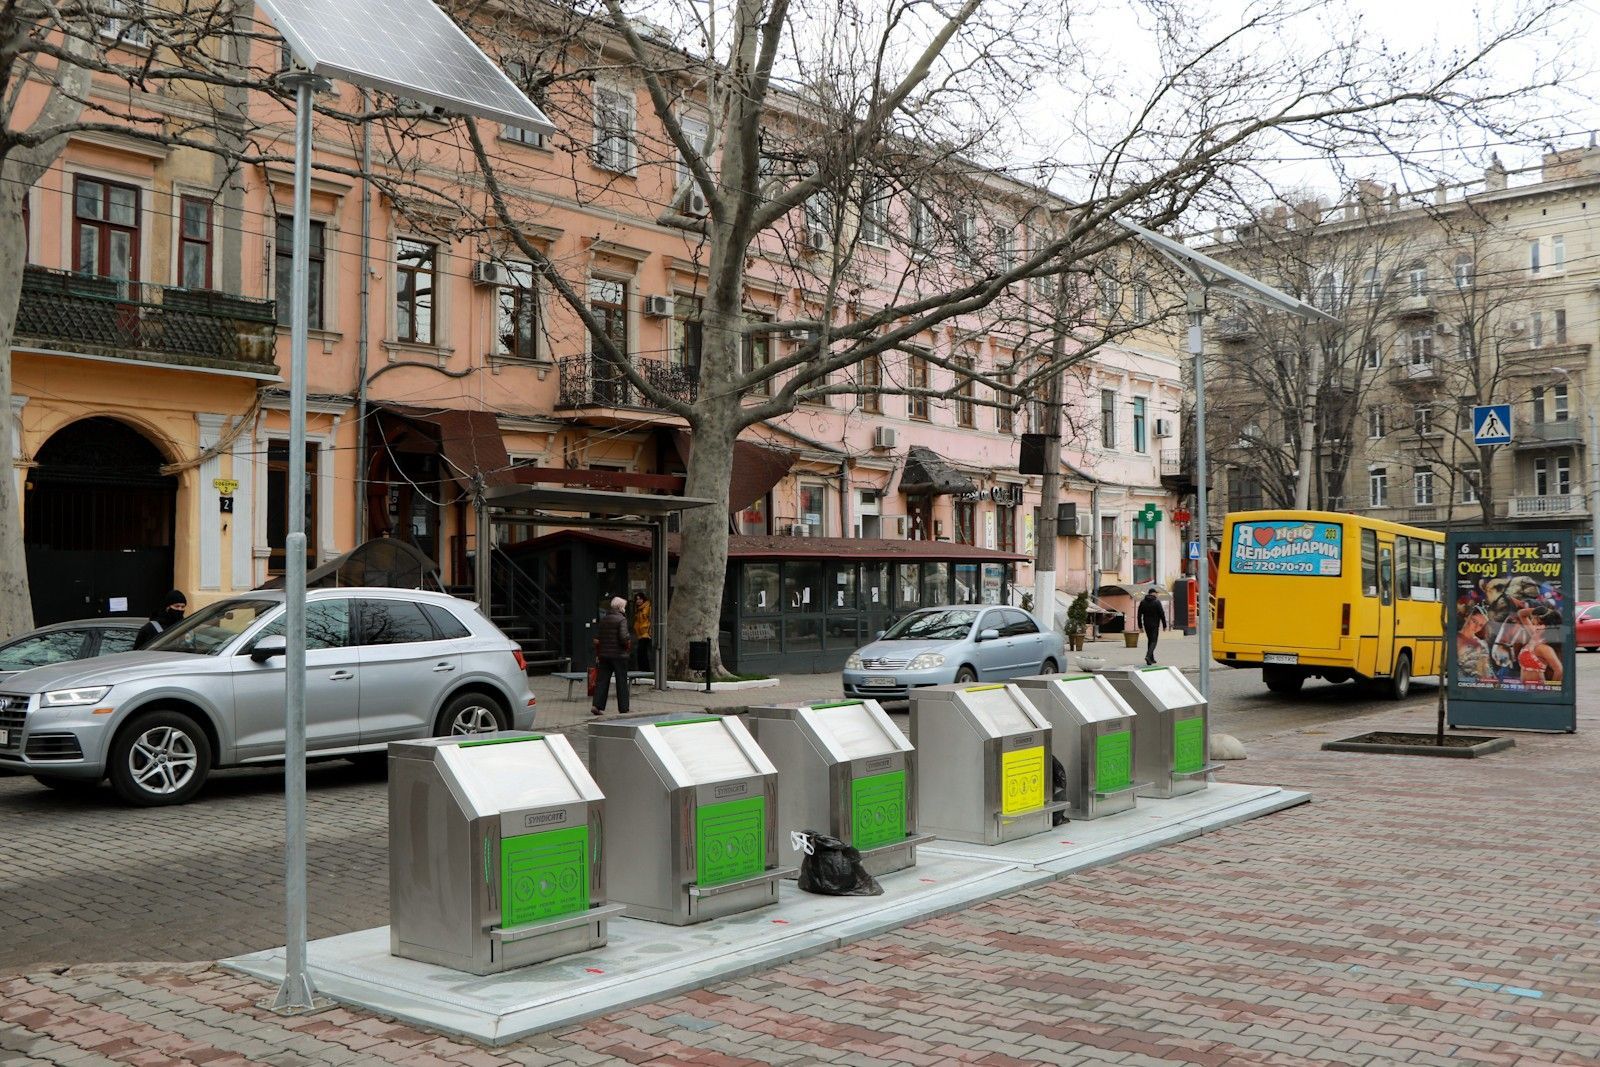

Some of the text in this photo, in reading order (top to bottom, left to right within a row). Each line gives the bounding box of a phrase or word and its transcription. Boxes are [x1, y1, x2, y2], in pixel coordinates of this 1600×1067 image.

[224, 500, 229, 510] 2
[1238, 525, 1253, 546] Я
[1461, 543, 1470, 554] 6
[1480, 547, 1540, 561] ЦИРК
[1546, 542, 1560, 553] 11
[1458, 561, 1498, 577] Сходу
[1511, 560, 1561, 577] Заходу
[528, 812, 563, 825] SYNDICATE
